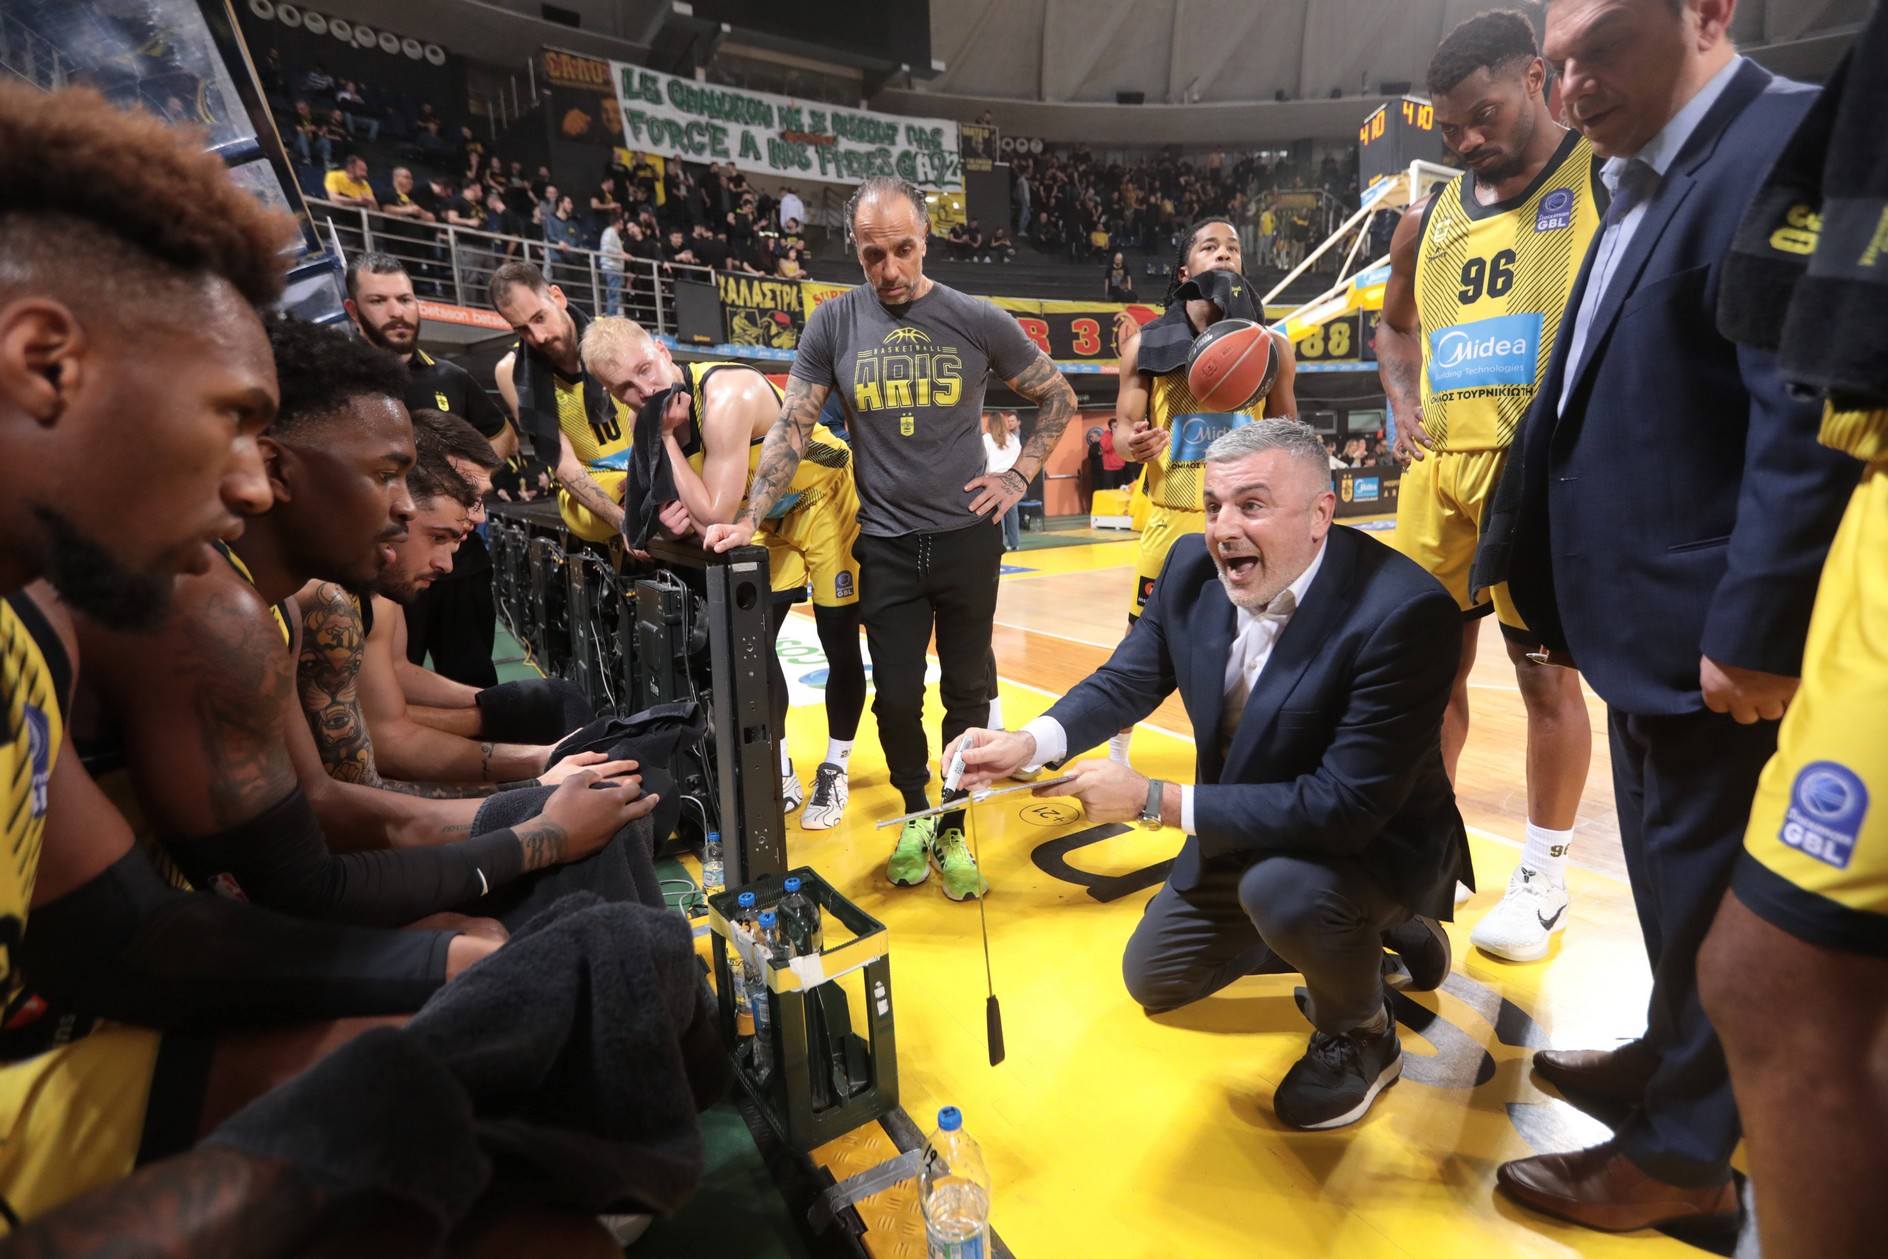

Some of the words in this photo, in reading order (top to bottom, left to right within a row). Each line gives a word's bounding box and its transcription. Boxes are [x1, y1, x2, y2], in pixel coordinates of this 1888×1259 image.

[622, 67, 664, 105] LE
[905, 124, 944, 150] PAS
[625, 108, 730, 159] FORCE
[739, 130, 762, 161] A
[767, 138, 812, 171] NOS
[1537, 218, 1567, 230] GBL
[1457, 248, 1517, 305] 96
[812, 289, 846, 306] SUP
[419, 304, 469, 321] betsson
[873, 345, 942, 355] BASKETBALL
[1071, 318, 1100, 356] 3
[1294, 322, 1351, 357] 88
[1440, 334, 1527, 365] Midea
[854, 353, 962, 412] ARIS
[1435, 370, 1462, 381] Building
[1465, 364, 1524, 376] Technologies
[1456, 387, 1534, 400] ΤΟΥΡΝΙΚΙΩΤΗ
[1185, 421, 1227, 443] Mid
[1171, 461, 1200, 470] ΟΜΙΛΟΣ
[1783, 822, 1844, 867] GBL
